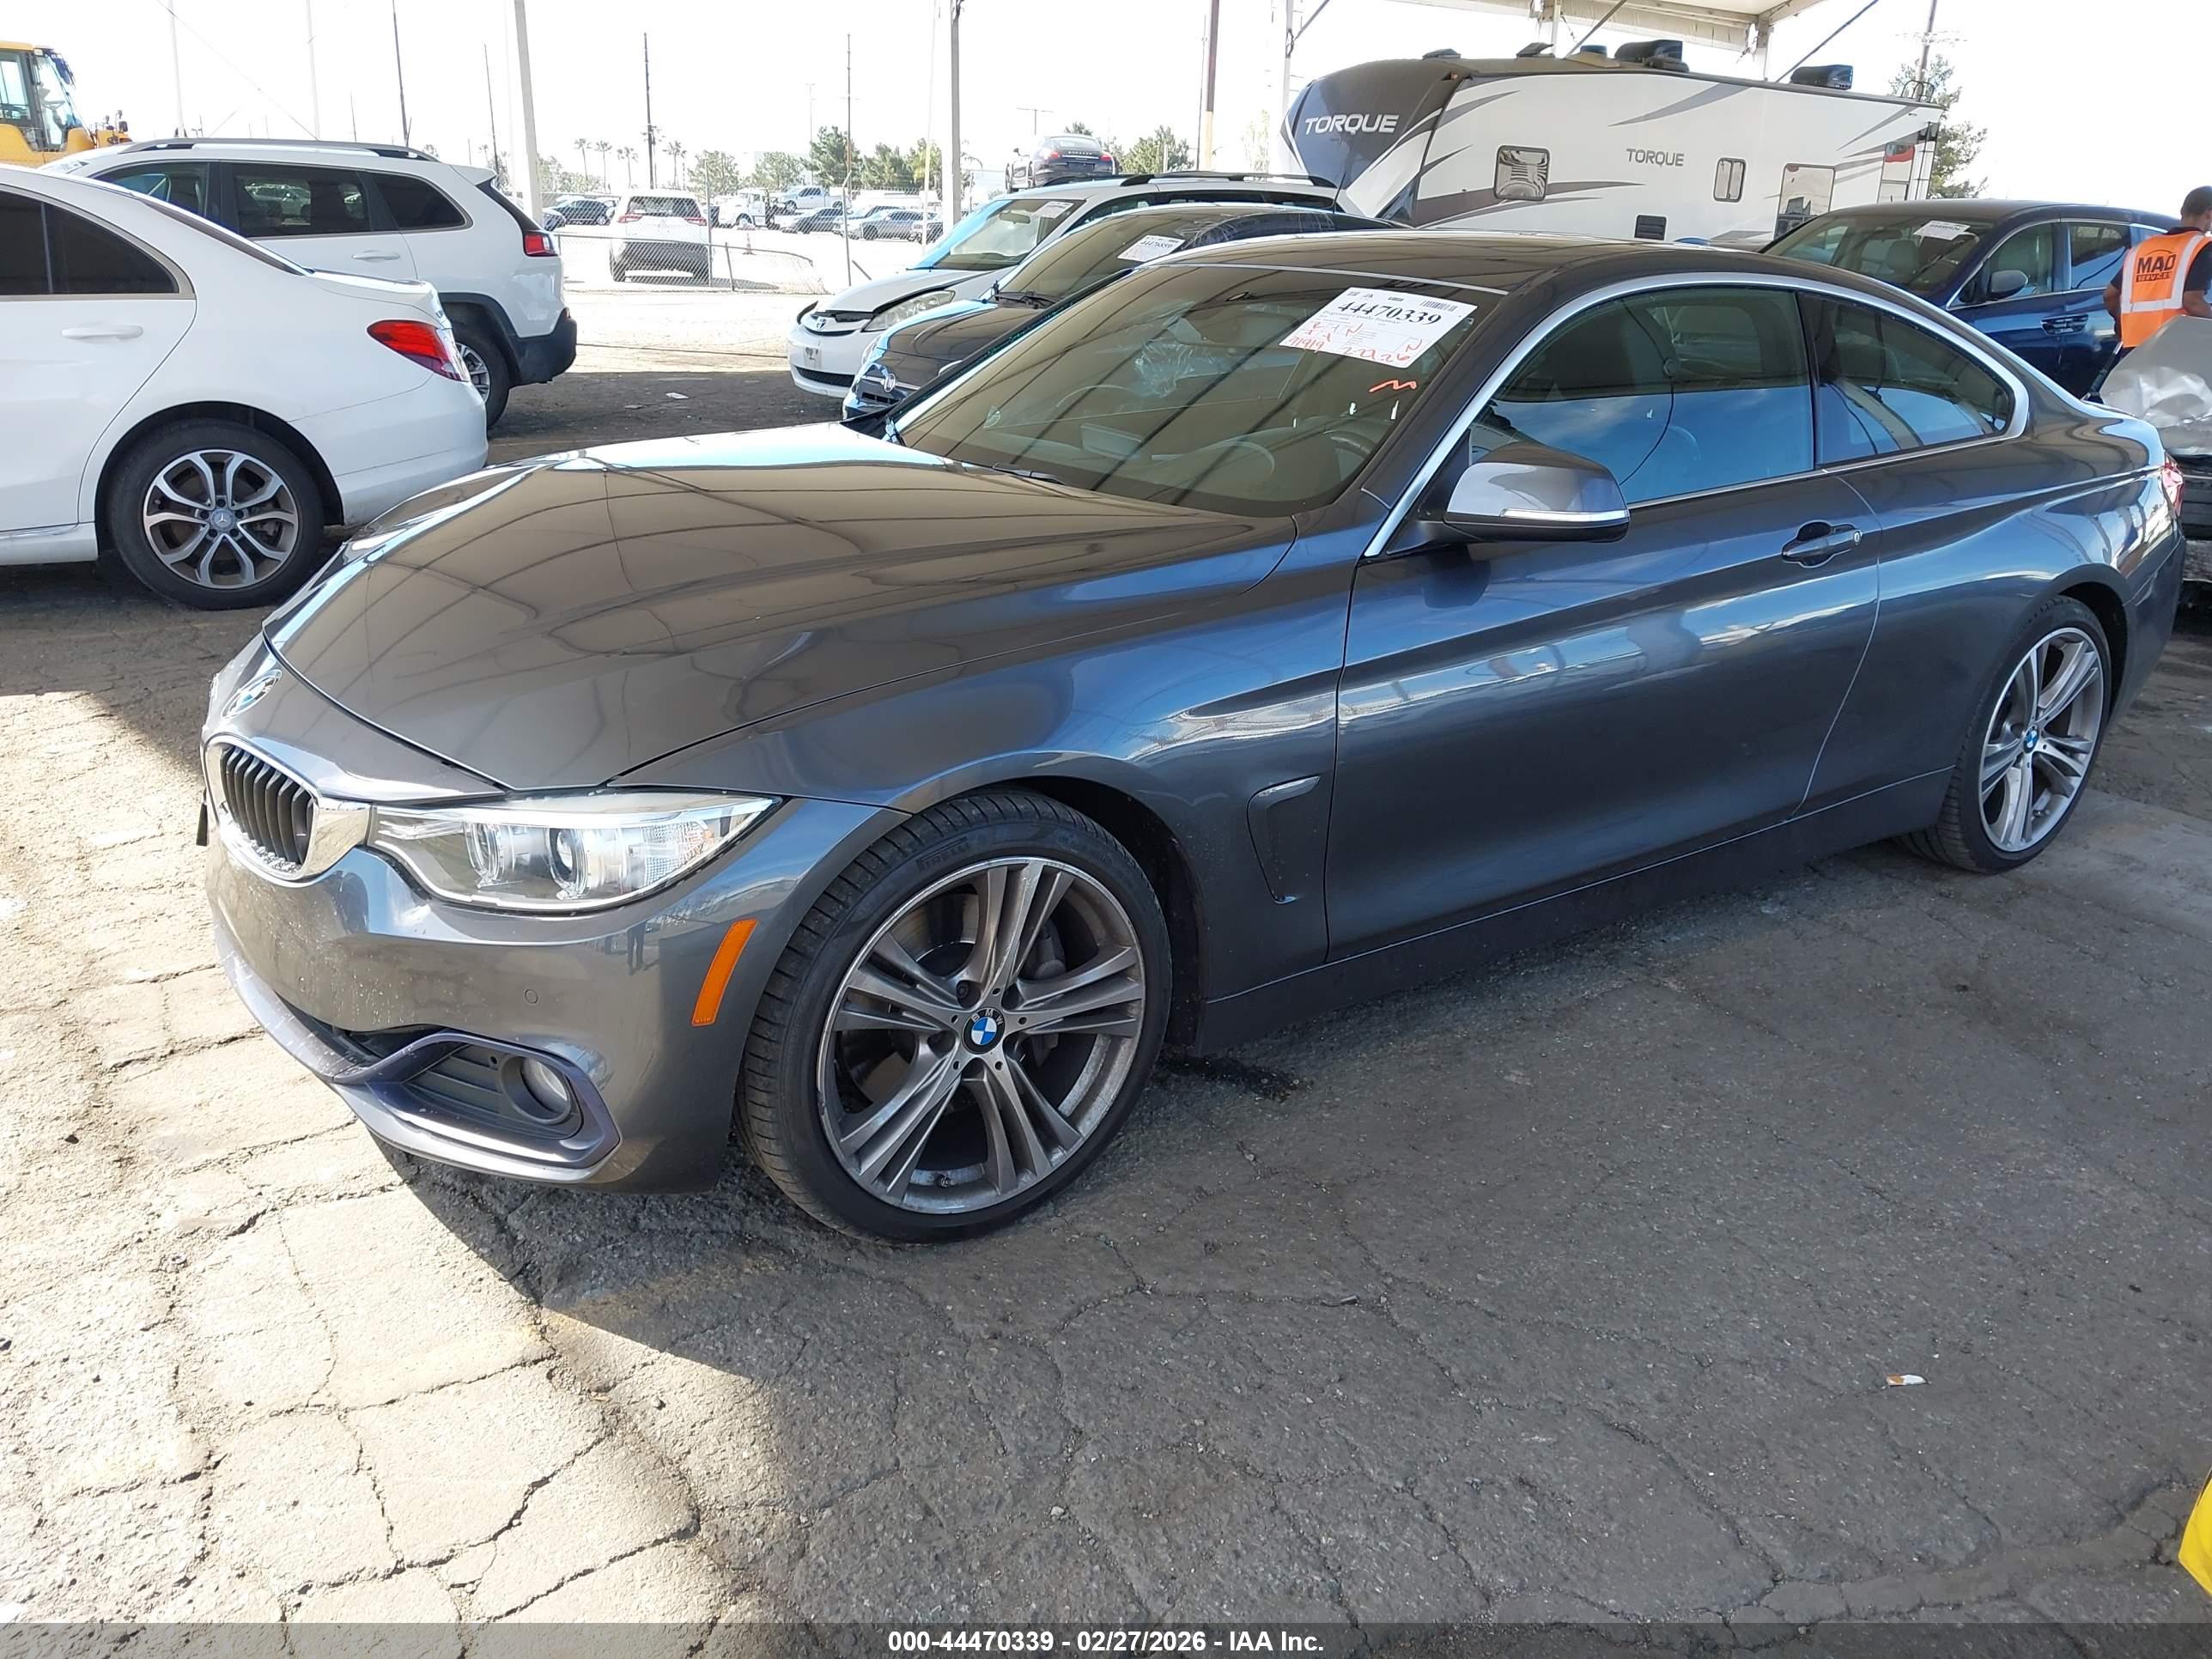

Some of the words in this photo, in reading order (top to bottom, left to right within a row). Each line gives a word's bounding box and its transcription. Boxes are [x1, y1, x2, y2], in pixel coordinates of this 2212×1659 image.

[1305, 114, 1399, 135] TORQUE
[1626, 149, 1685, 167] TORQUE
[2137, 254, 2177, 274] MAD
[1338, 301, 1442, 325] 44470339
